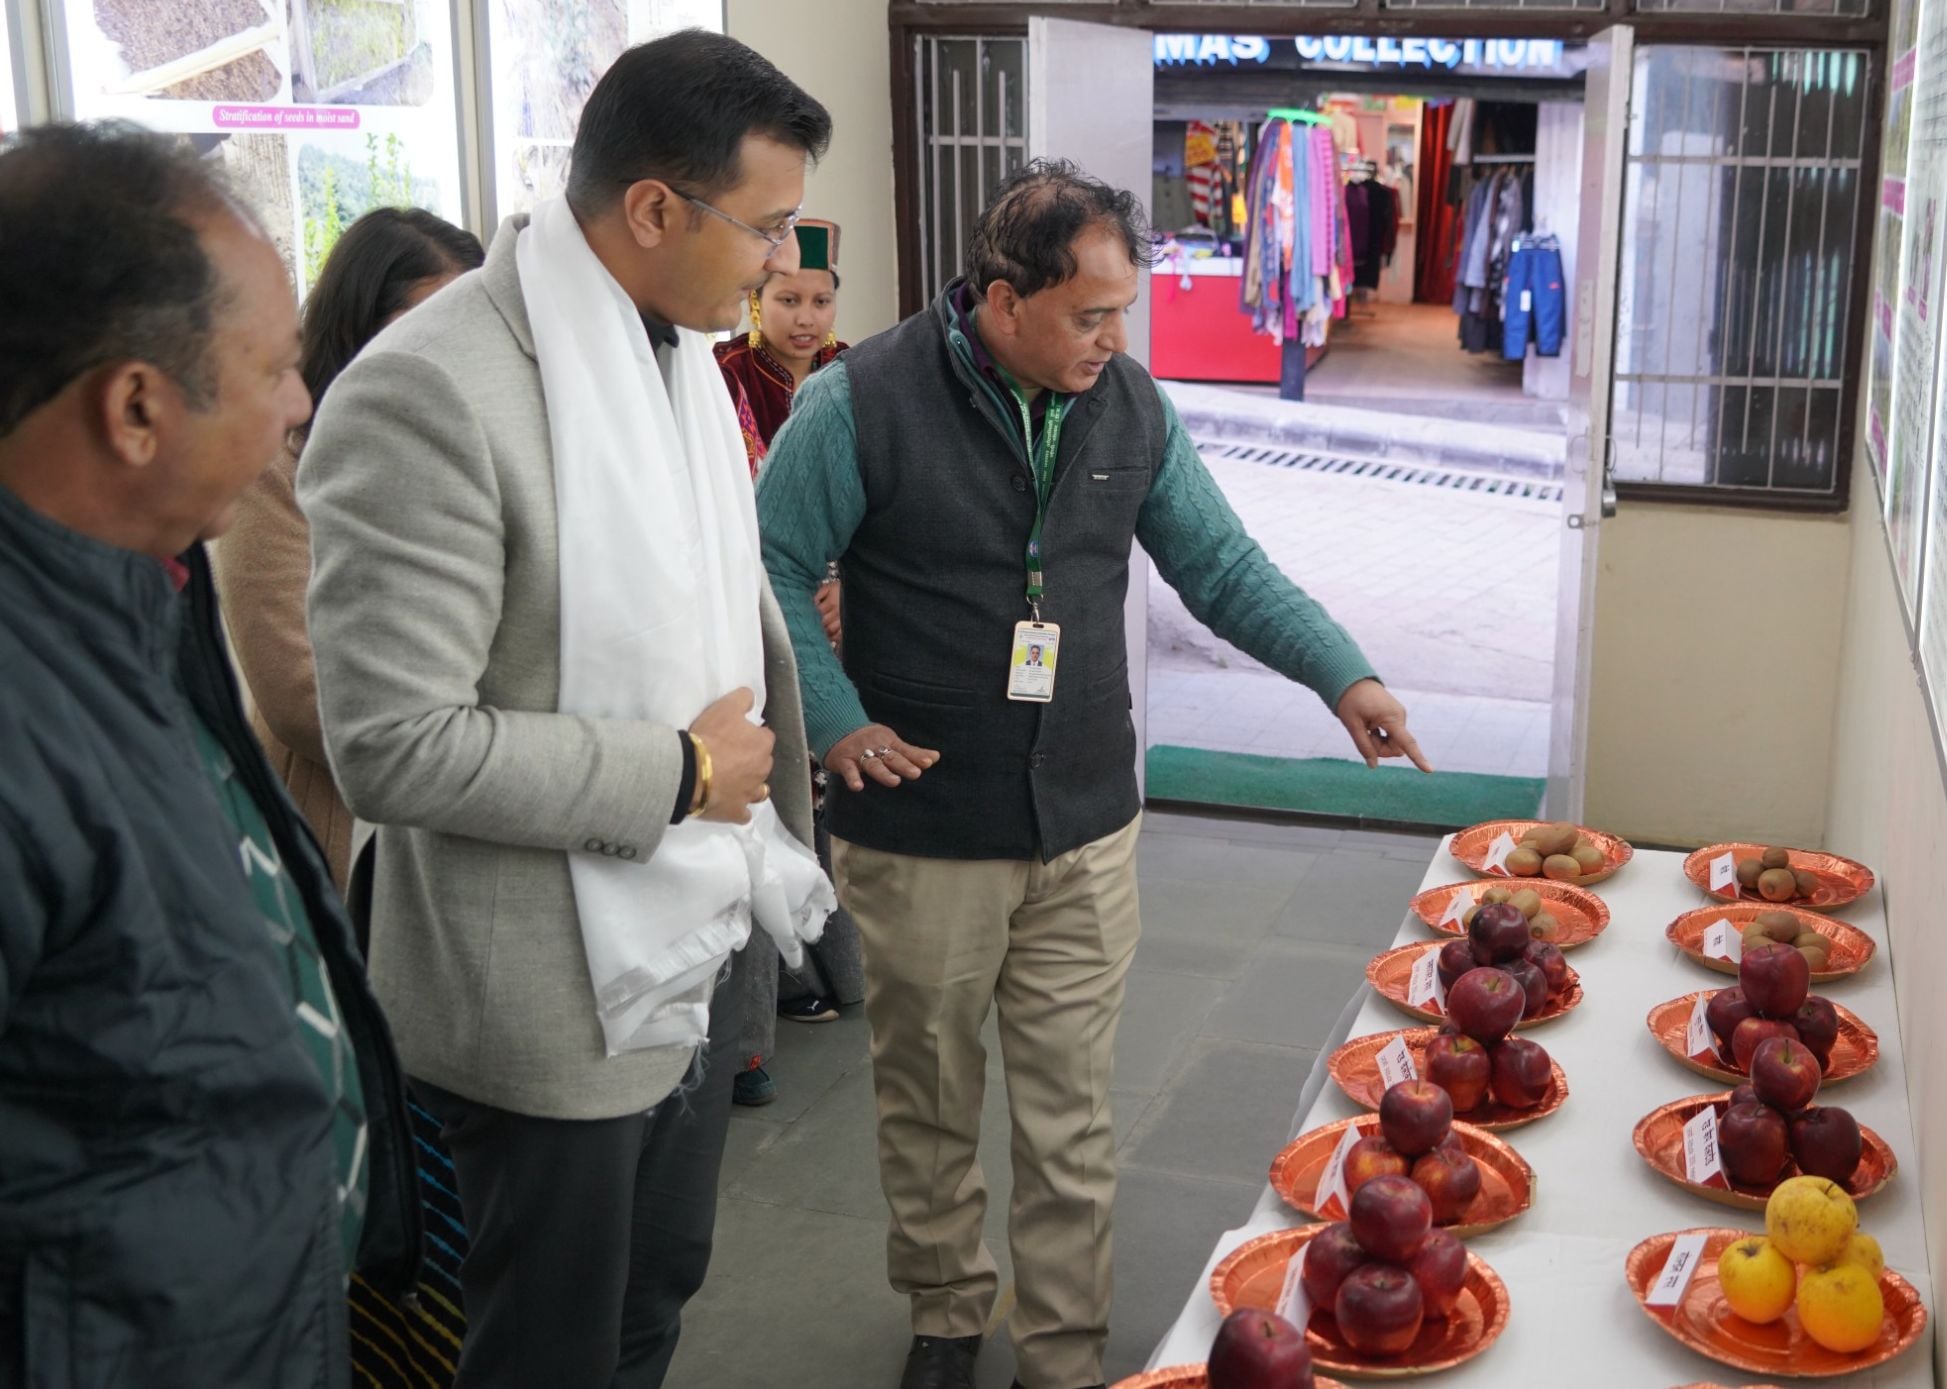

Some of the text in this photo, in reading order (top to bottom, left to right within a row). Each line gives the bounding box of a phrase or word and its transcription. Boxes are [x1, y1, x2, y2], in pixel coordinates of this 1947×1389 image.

[1295, 35, 1560, 69] COLLECTION
[219, 109, 355, 125] Stratification of seeds in moist sand
